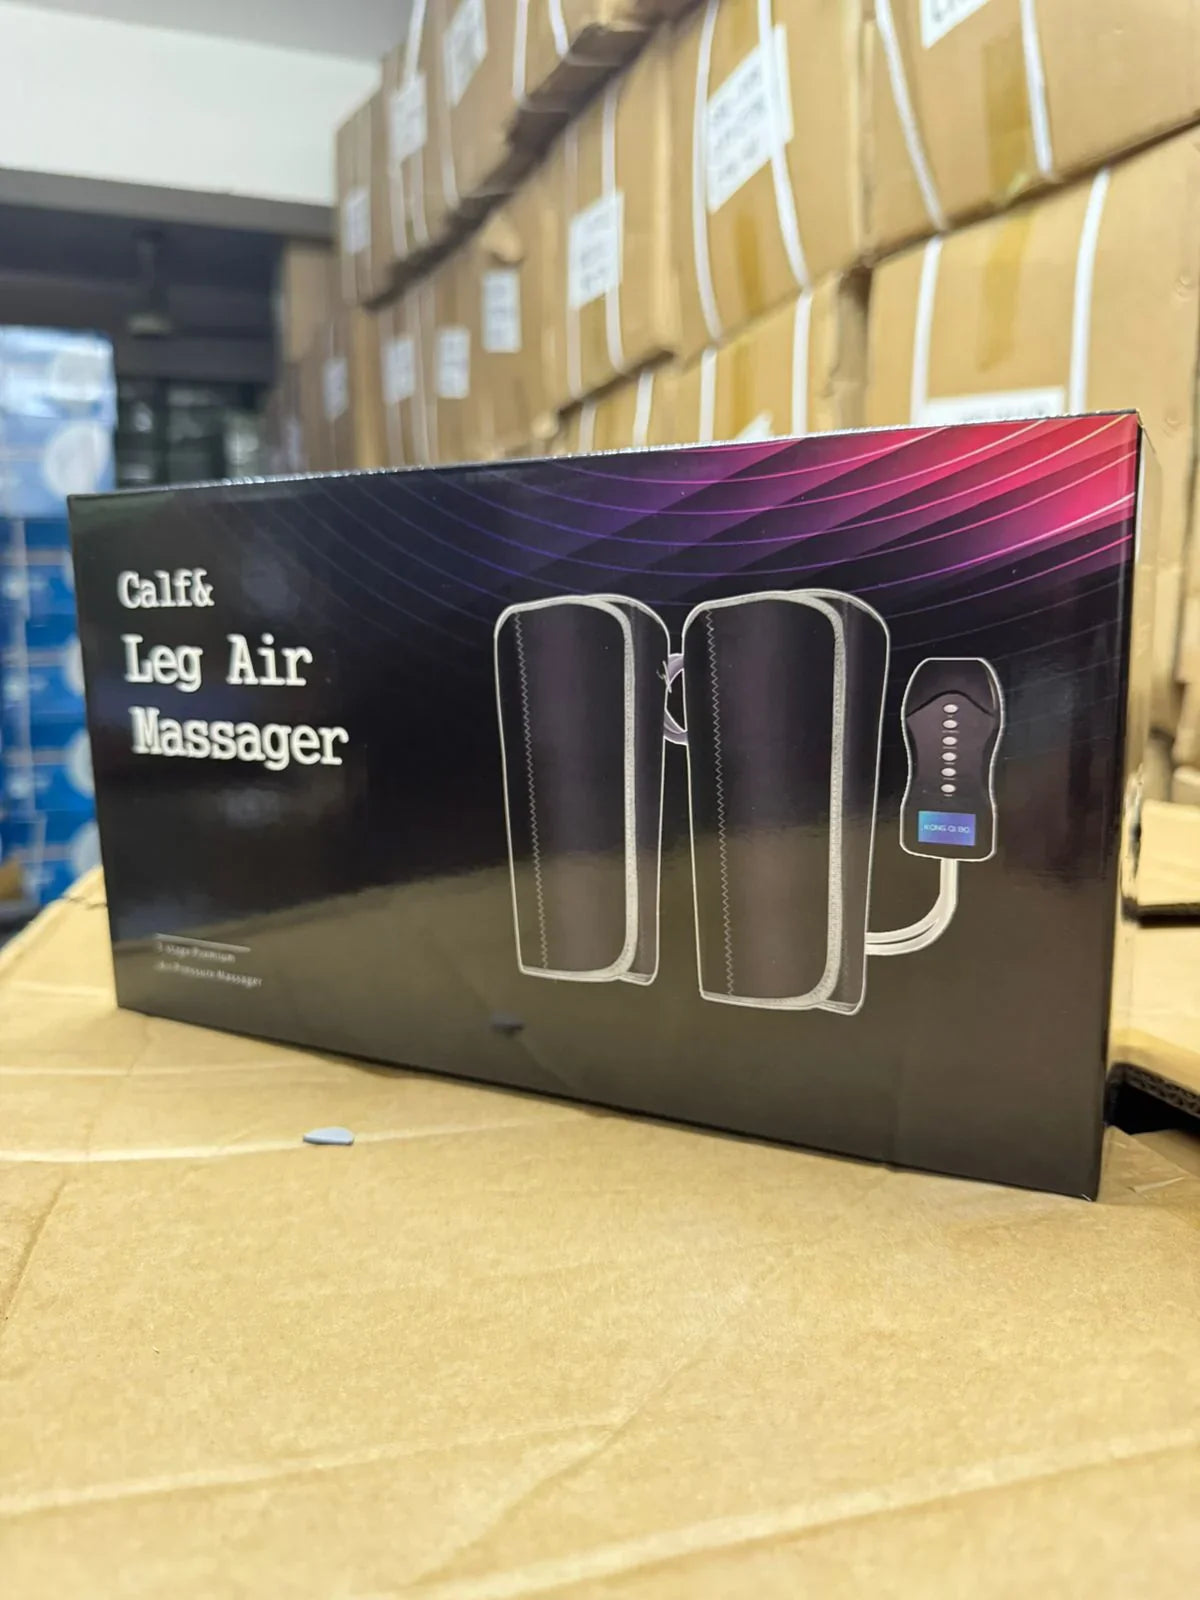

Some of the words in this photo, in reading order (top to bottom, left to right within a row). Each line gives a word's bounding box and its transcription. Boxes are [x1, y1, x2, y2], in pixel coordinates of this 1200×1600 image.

[117, 567, 215, 608] Calf&
[121, 633, 203, 692] Leg
[225, 632, 313, 686] Air
[128, 705, 349, 770] Massager
